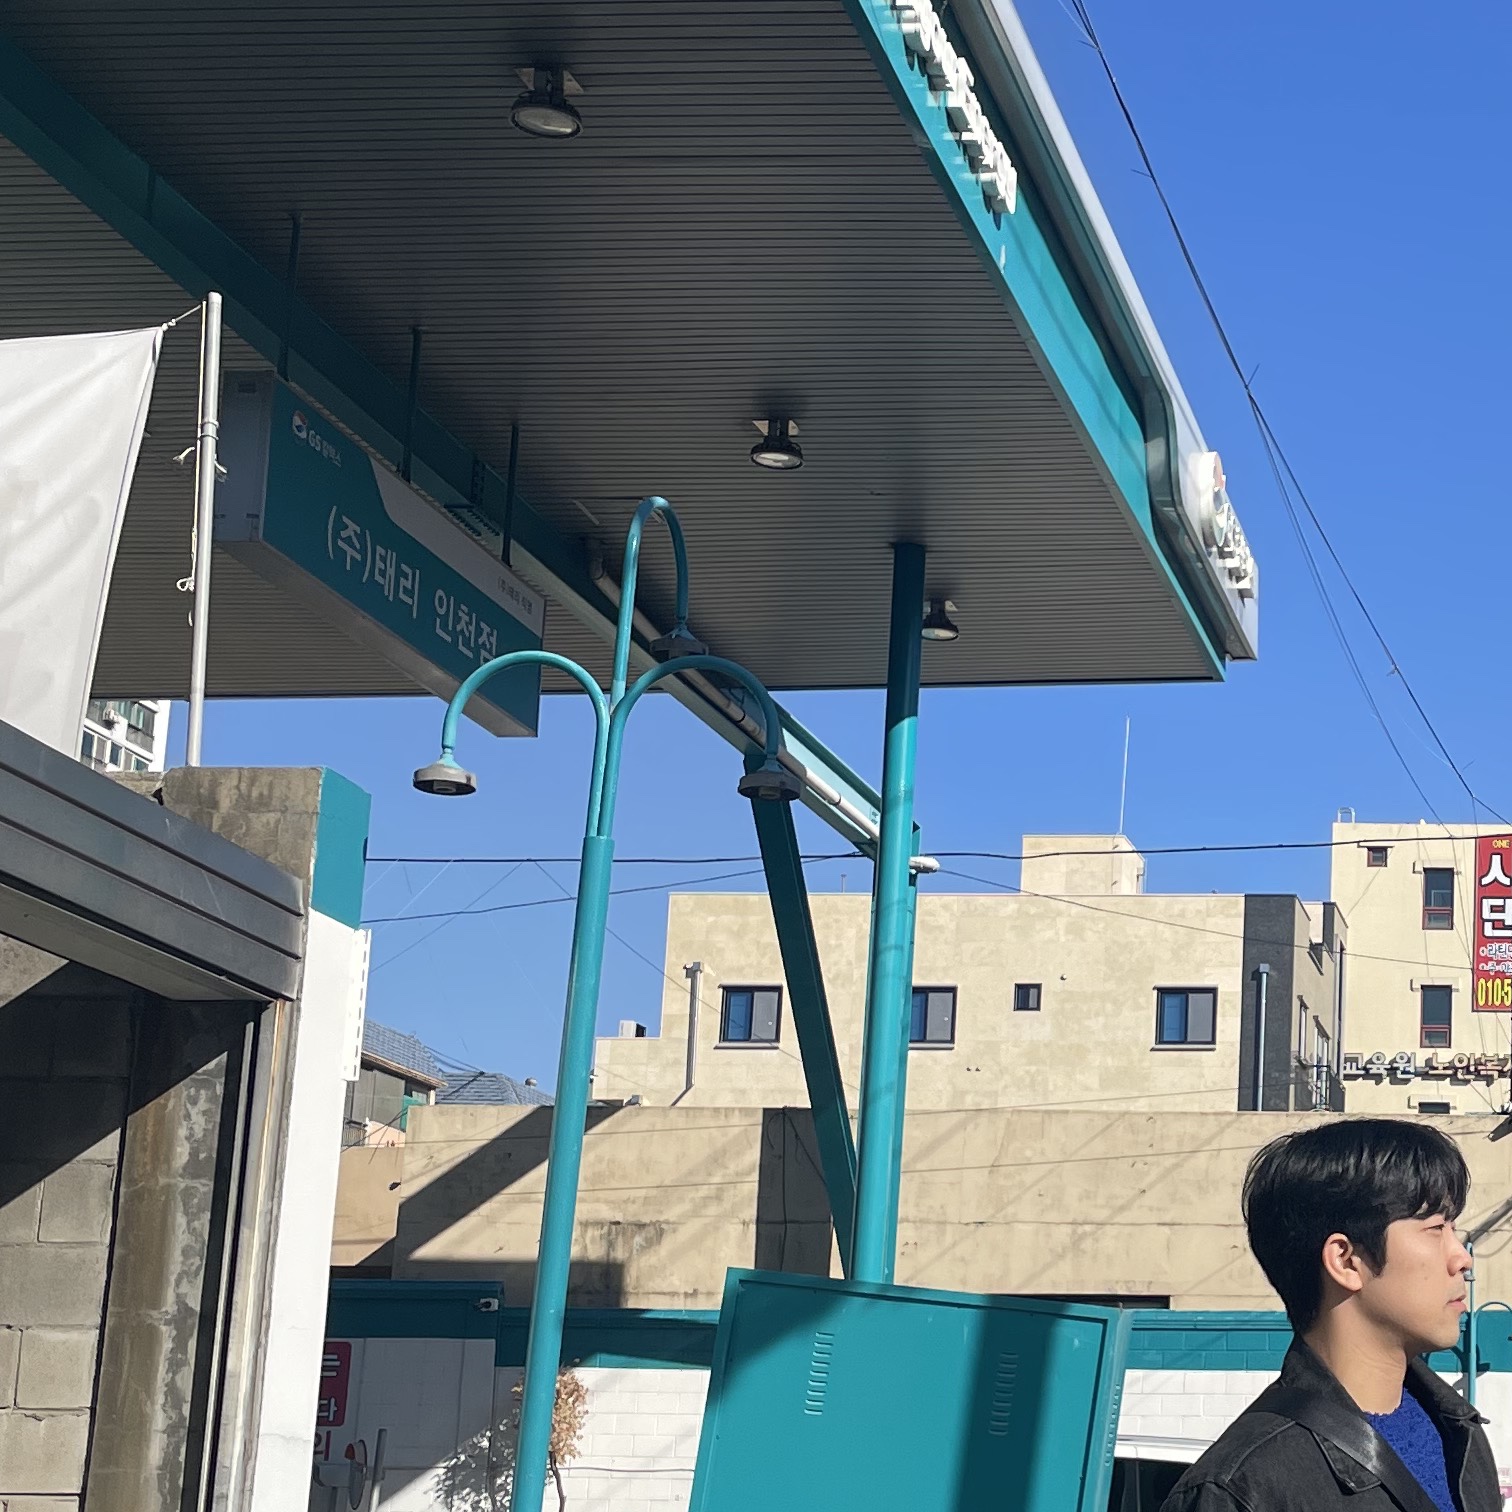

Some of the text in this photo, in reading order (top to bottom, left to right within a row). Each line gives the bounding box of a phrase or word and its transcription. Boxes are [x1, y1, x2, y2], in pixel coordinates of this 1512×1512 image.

[327, 504, 497, 667] (주)태리 인천점
[1492, 839, 1510, 849] ONE
[1342, 1052, 1416, 1079] 교육원
